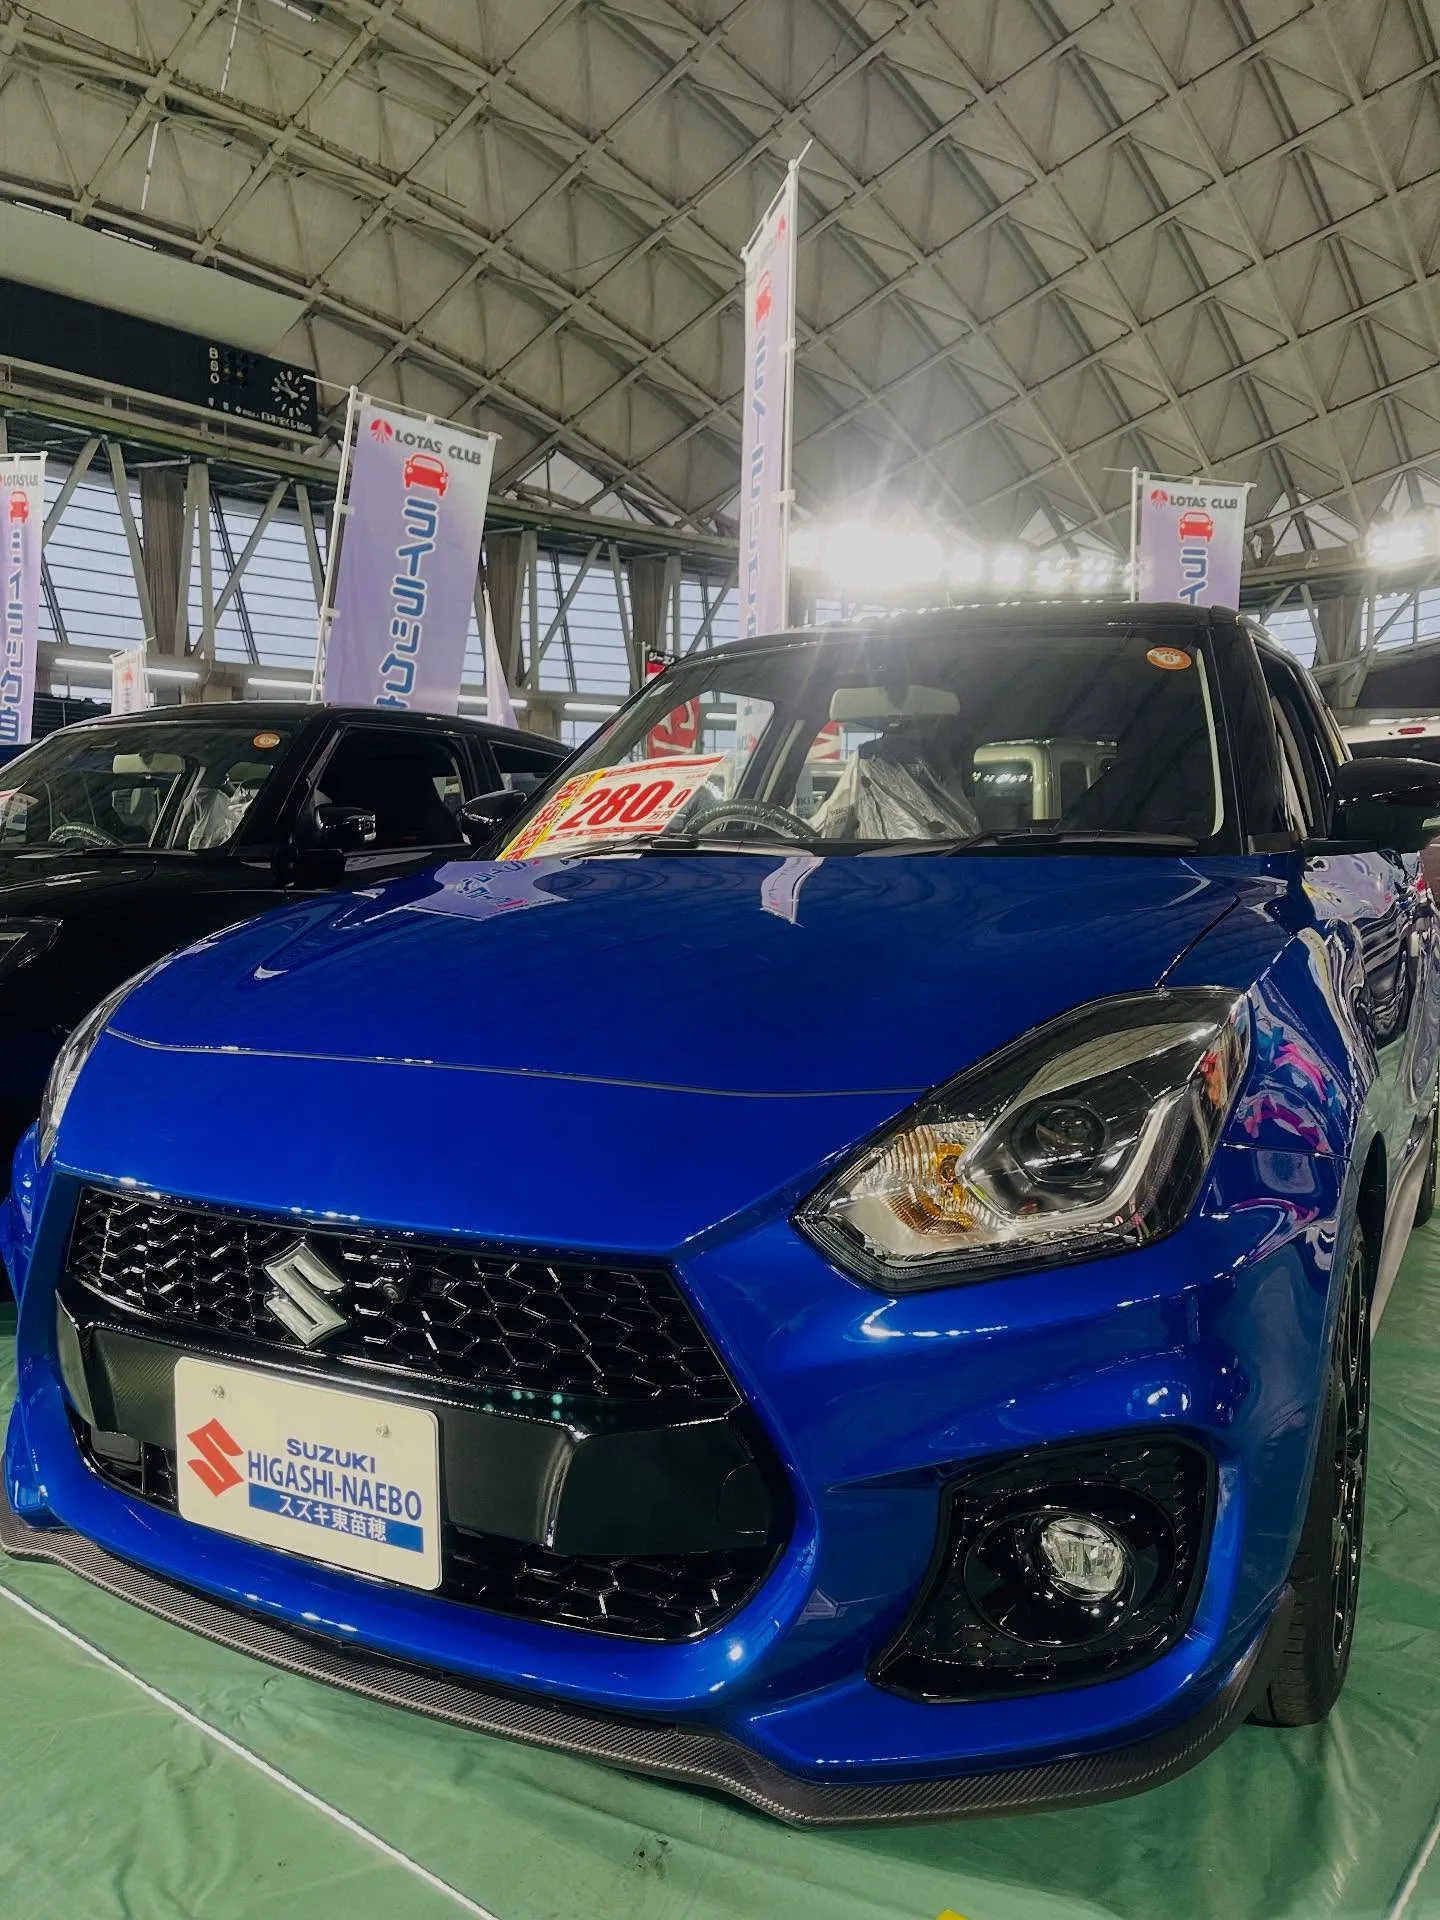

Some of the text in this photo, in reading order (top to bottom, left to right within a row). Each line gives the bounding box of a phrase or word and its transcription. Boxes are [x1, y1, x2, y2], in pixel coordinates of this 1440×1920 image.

[395, 430, 481, 465] LOTAS CLUB
[1170, 495, 1238, 509] LOTAS CLUB
[286, 1438, 376, 1474] SUZUKI
[247, 1450, 422, 1521] HIGASHI-NAEBO
[278, 1494, 387, 1542] スズキ東苗穂
